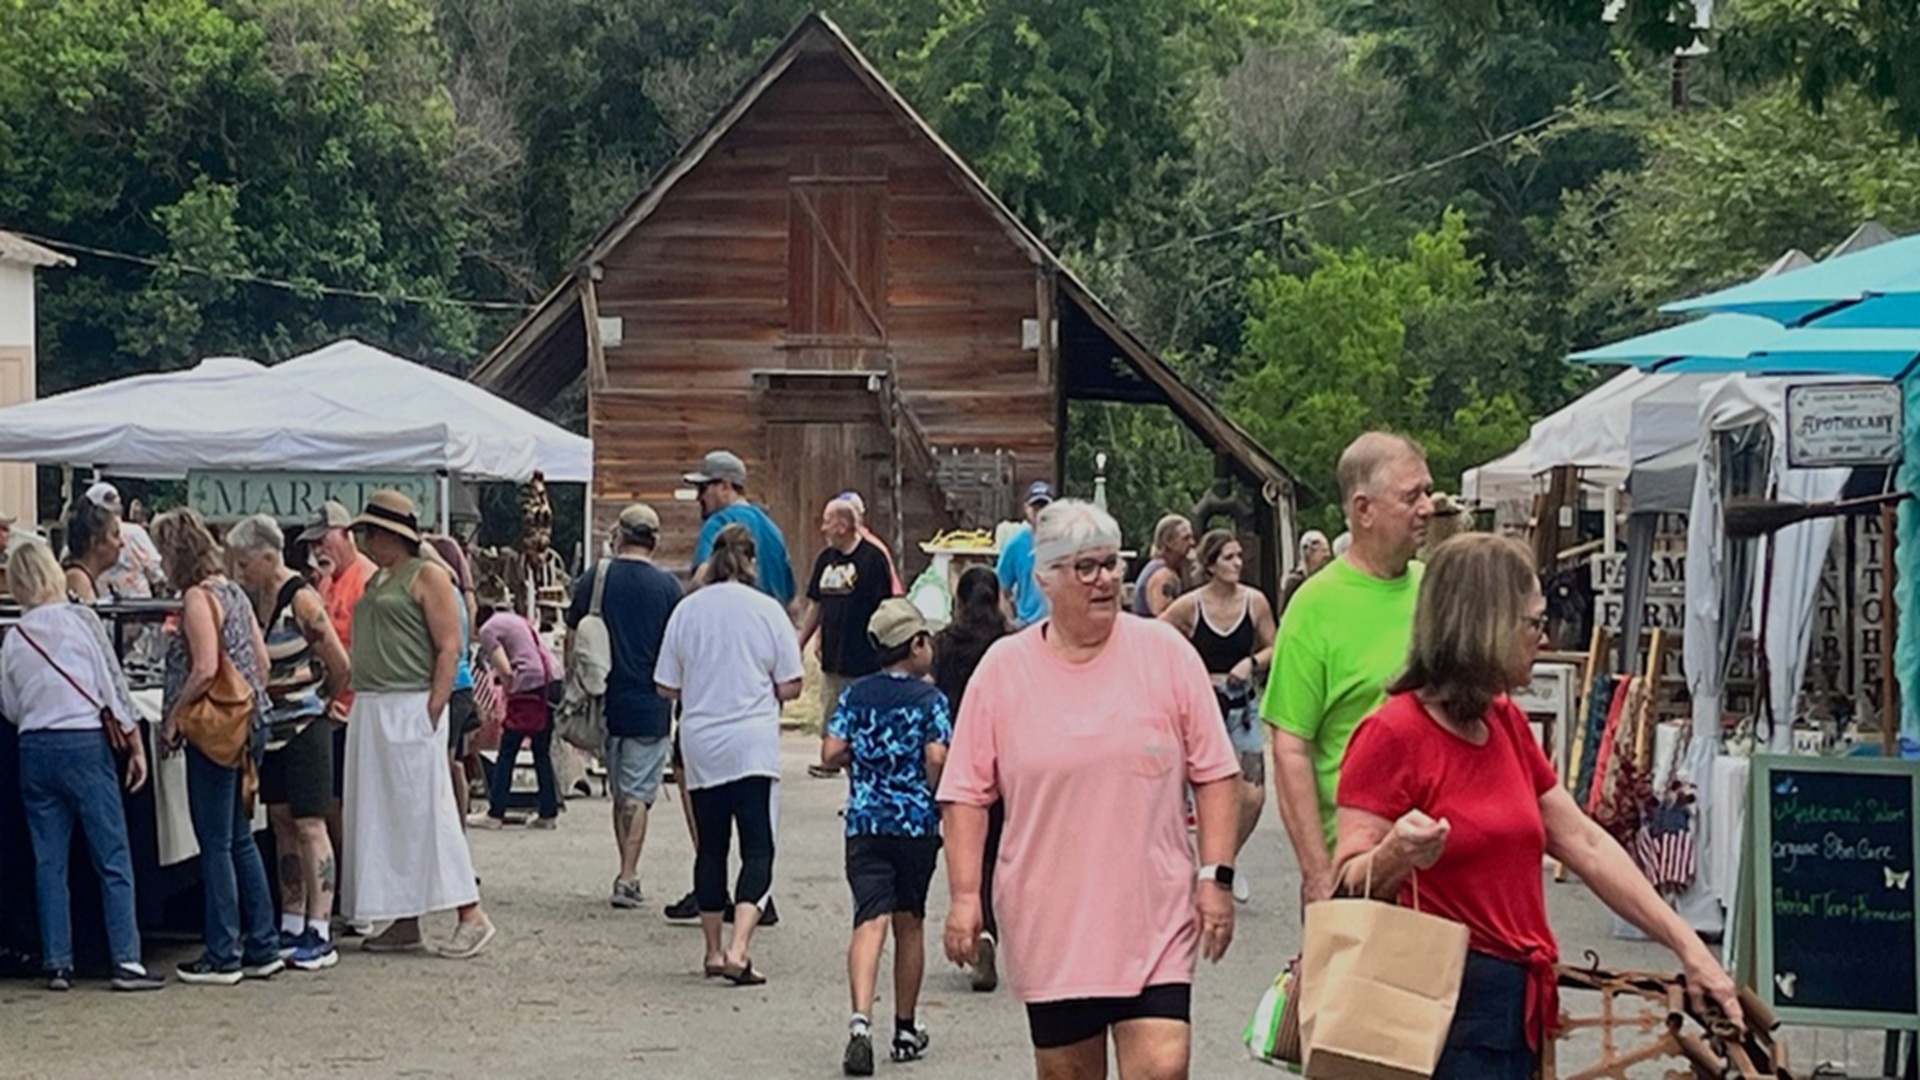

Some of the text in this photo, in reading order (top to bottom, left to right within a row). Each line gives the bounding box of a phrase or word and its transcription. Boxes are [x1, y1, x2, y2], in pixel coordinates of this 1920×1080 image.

[212, 479, 413, 517] MARKE
[1603, 602, 1685, 628] FRM
[1857, 837, 1896, 860] Care
